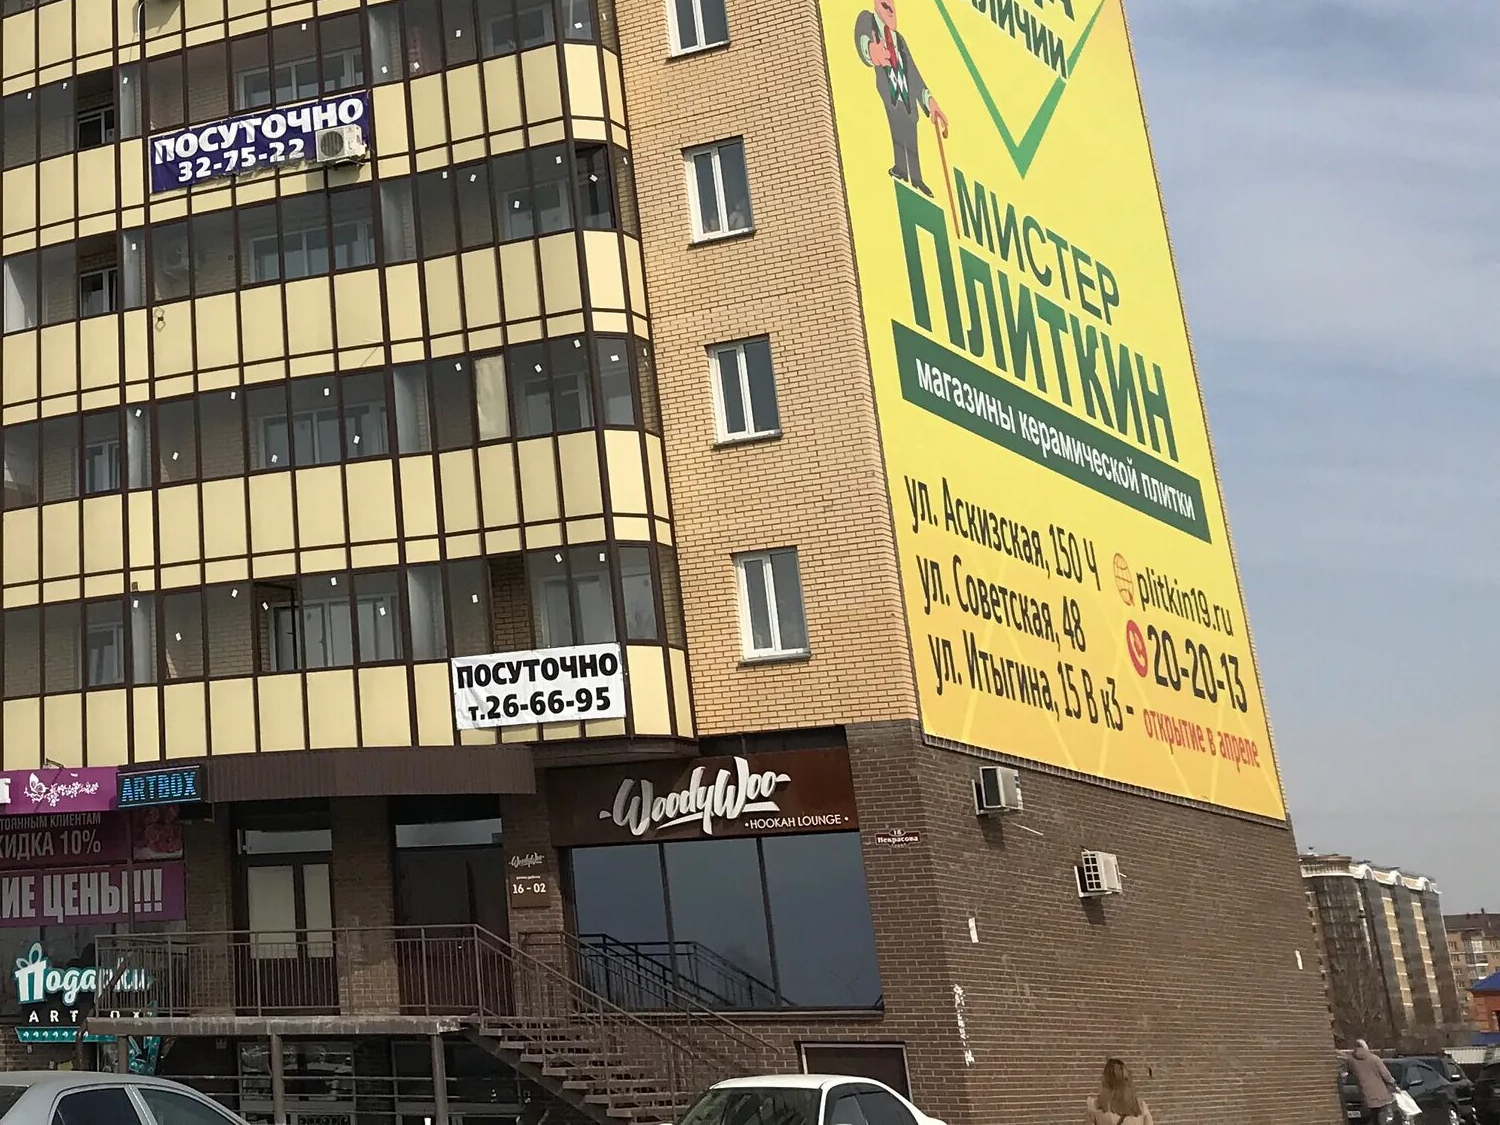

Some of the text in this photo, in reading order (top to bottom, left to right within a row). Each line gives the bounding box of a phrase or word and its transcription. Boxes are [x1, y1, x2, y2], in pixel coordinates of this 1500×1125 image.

[155, 98, 364, 165] ПОСУТОЧНО
[178, 138, 305, 182] 32-75-22
[953, 166, 1120, 323] МИСТЕР
[895, 180, 1179, 463] ПЛИТКИН
[916, 357, 1197, 522] магазины керамической плитки
[905, 475, 937, 535] ул.
[942, 476, 1050, 572] Аскизская,
[1047, 523, 1083, 583] 150
[916, 554, 1087, 653] ул. Советская, 48
[1136, 567, 1234, 637] plitkin19.ru
[456, 652, 618, 689] ПОСУТОЧНО
[1147, 625, 1247, 713] 20-20-13
[469, 687, 611, 720] т.26-66-95
[928, 634, 962, 696] ул.
[964, 631, 1059, 723] Итыгина,
[1058, 662, 1081, 718] 15
[1143, 708, 1205, 755] открытие
[1208, 727, 1216, 755] в
[1217, 730, 1260, 772] апреле
[121, 771, 197, 802] ARTBOX
[49, 812, 101, 827] КЛИЕНТАМ
[60, 830, 101, 856] 10%
[797, 813, 842, 826] LOUNGE
[43, 868, 164, 923] ЦЕНЫ!!!
[512, 884, 525, 894] 16
[533, 883, 547, 893] 02
